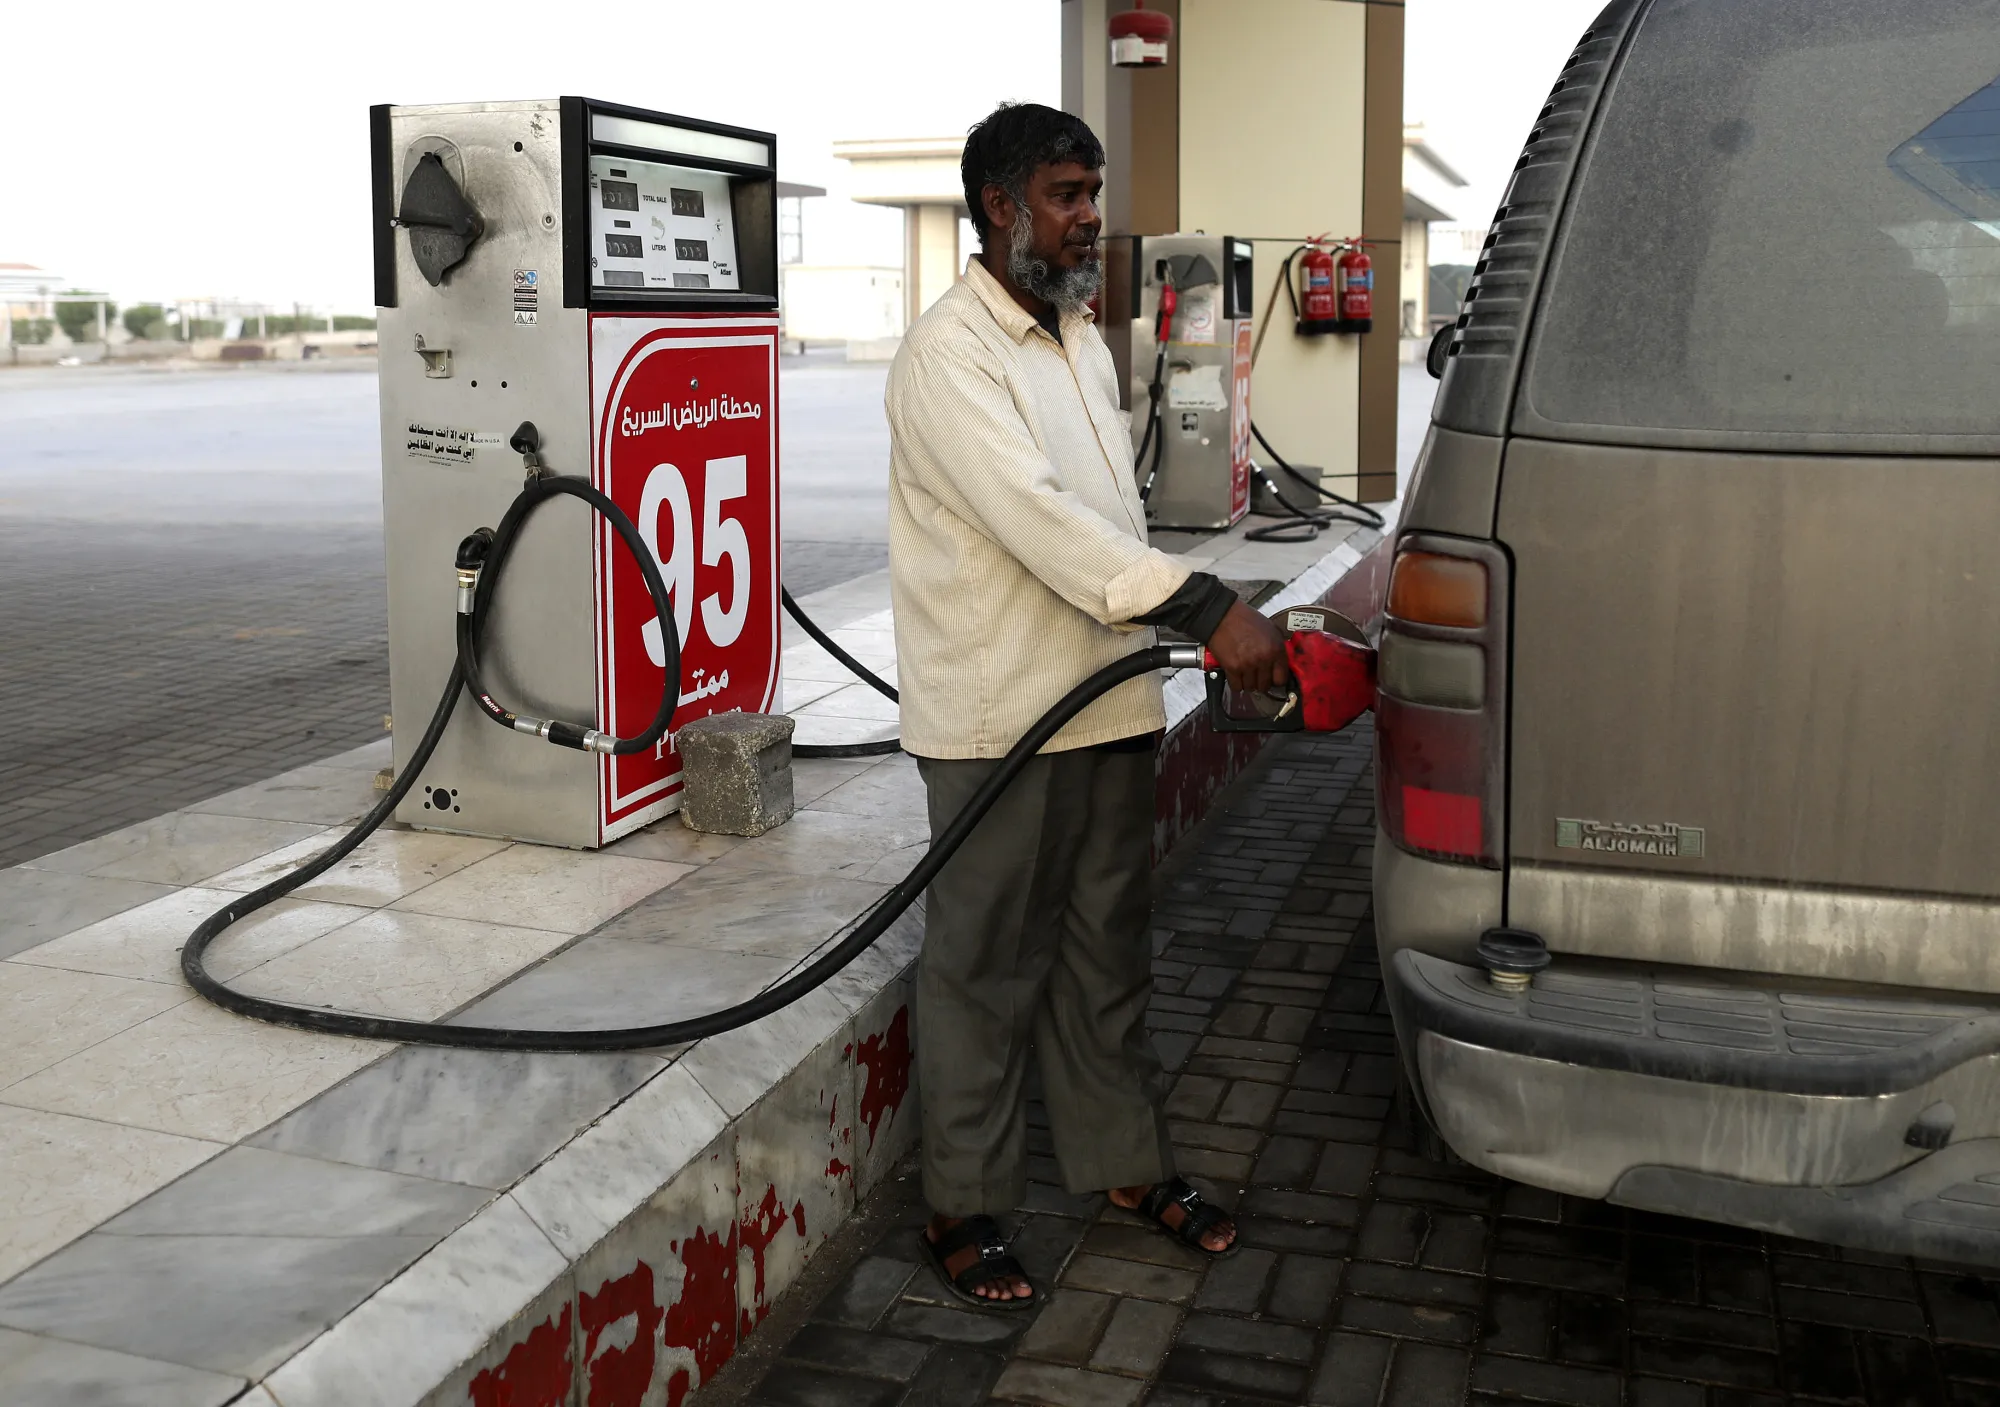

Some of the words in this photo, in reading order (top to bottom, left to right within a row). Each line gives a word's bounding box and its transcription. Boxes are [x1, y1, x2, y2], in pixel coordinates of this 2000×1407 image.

[673, 398, 717, 431] الرياض
[720, 393, 761, 420] محطة
[621, 402, 671, 437] السريع
[409, 424, 434, 438] سبحانك
[436, 427, 449, 438] أنت
[435, 443, 444, 454] من
[446, 444, 462, 455] كنت
[463, 448, 475, 460] إني
[637, 454, 751, 668] 95
[482, 695, 500, 713] Matrix
[1582, 837, 1677, 856] ALJOMAIH
